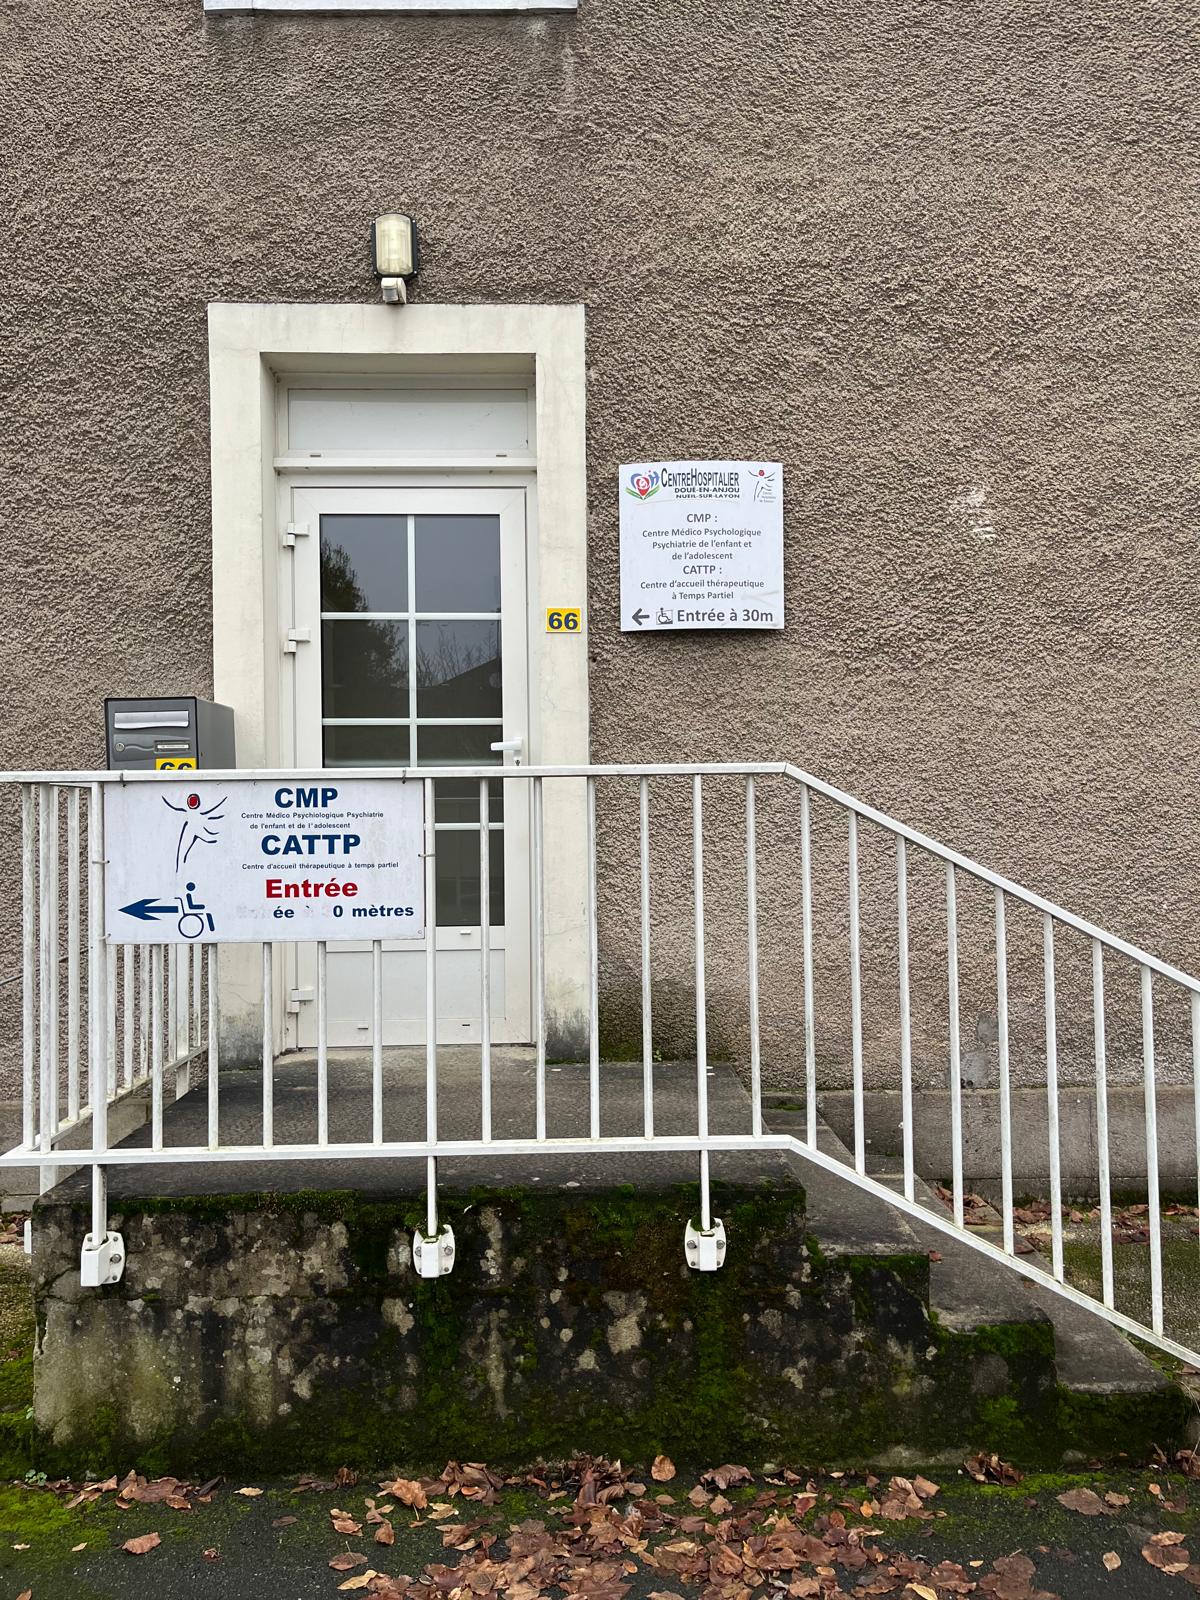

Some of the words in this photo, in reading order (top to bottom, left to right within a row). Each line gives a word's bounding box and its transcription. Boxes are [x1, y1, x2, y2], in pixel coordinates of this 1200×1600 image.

[686, 513, 712, 523] CMP
[642, 530, 670, 538] Centre
[671, 528, 702, 536] Médico
[704, 528, 762, 538] Psychologique
[652, 540, 697, 550] Psychiatrie
[698, 540, 709, 548] de
[682, 565, 716, 574] CATTP
[640, 581, 668, 589] Centre
[706, 580, 764, 589] thérapeutique
[680, 592, 705, 600] Temps
[678, 609, 726, 622] Entrée
[730, 608, 738, 622] à
[742, 609, 773, 622] 30m
[548, 612, 578, 630] 66
[274, 788, 338, 808] CMP
[261, 834, 361, 856] CATTP
[266, 878, 358, 898] Entrée
[352, 905, 414, 918] mètres
